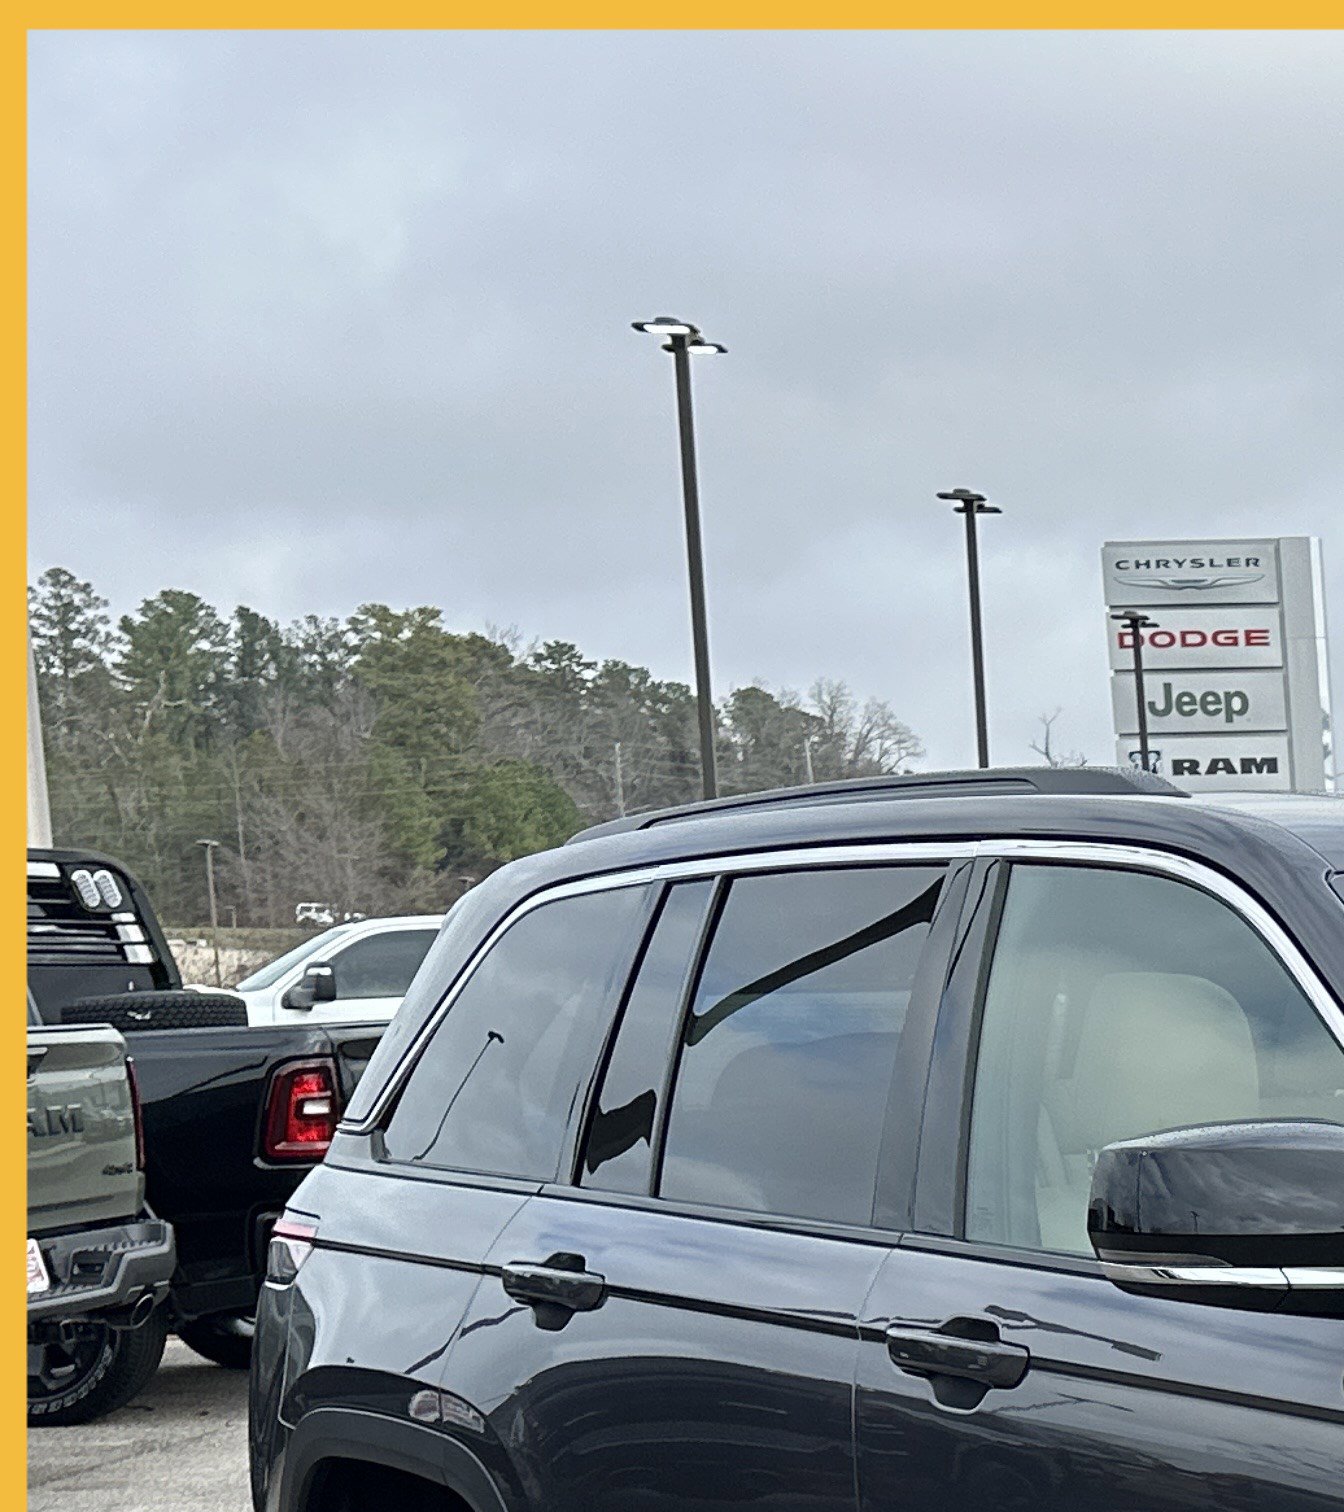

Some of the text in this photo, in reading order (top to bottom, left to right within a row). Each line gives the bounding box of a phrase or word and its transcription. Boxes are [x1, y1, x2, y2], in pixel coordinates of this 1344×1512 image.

[1115, 557, 1261, 570] CHRYSLER
[1117, 629, 1270, 649] DODGE
[1147, 682, 1249, 723] Jeep
[1171, 757, 1279, 776] RAM
